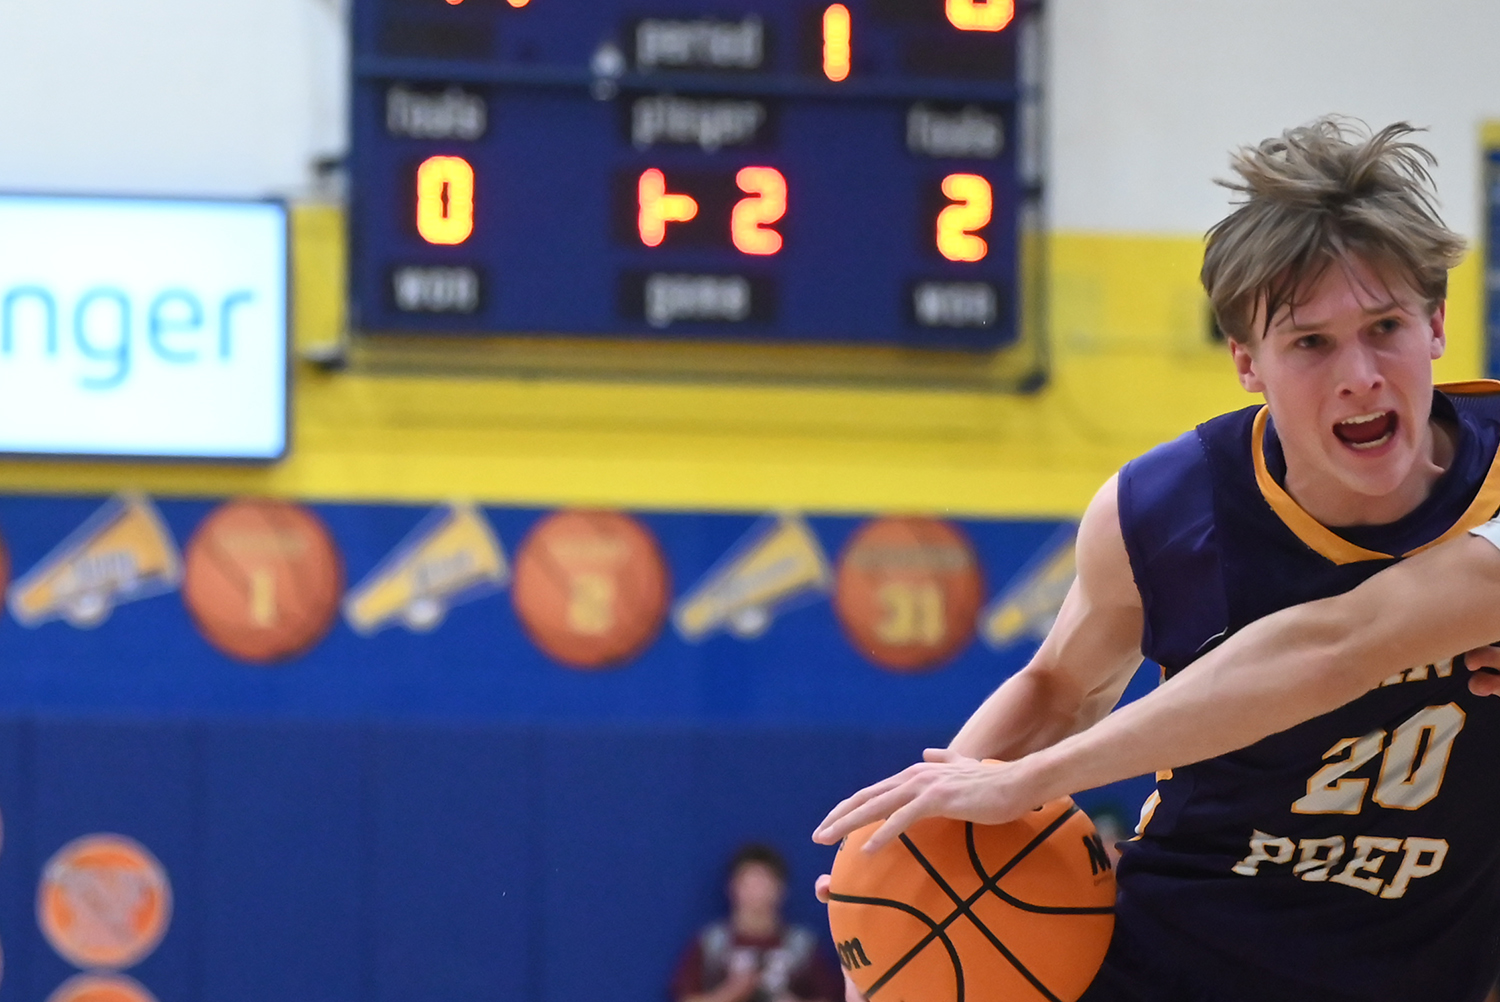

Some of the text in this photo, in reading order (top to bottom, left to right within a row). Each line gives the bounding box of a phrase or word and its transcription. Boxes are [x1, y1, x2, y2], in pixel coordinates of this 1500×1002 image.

[417, 156, 474, 245] 0
[936, 173, 992, 262] 2
[1290, 701, 1467, 815] 20
[1231, 828, 1450, 900] PREP
